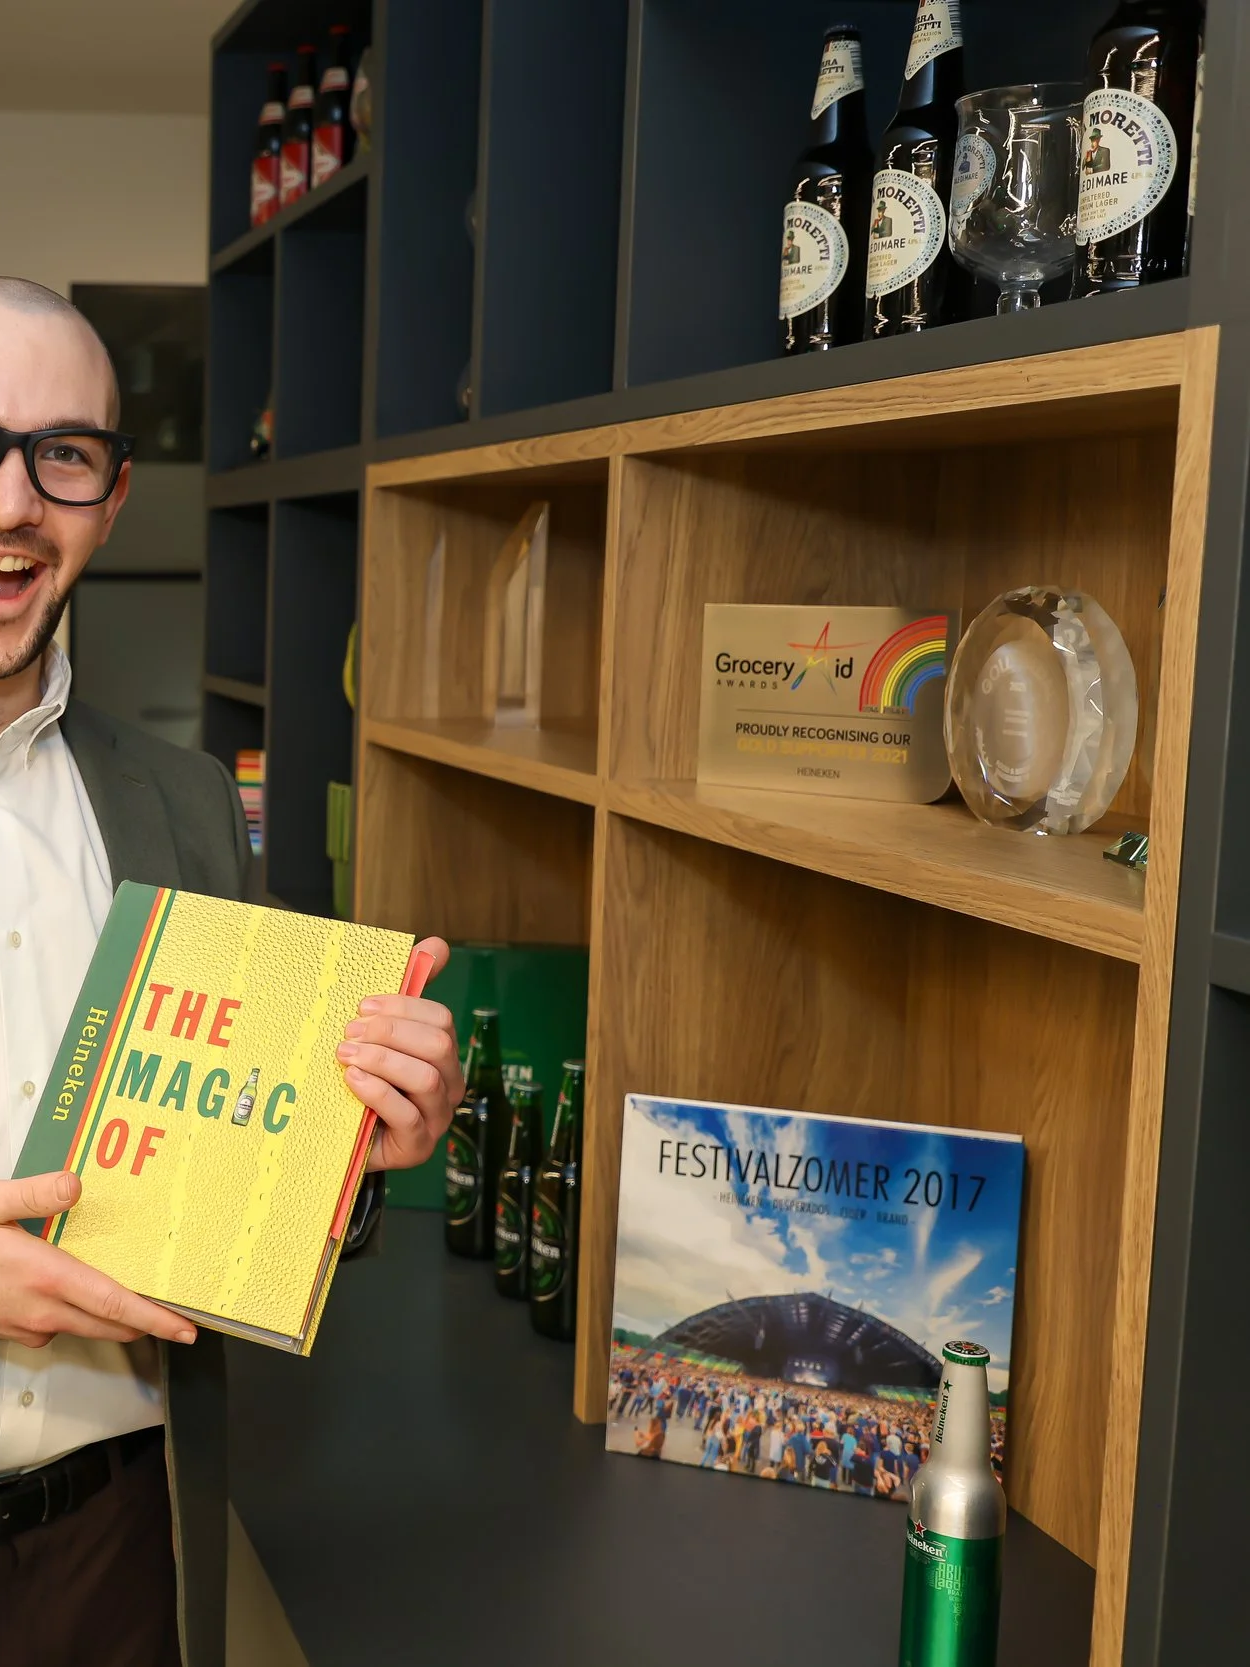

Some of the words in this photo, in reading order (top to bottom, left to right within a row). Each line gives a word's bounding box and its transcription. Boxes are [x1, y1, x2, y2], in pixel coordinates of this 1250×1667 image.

[1089, 110, 1153, 167] MORETTI
[876, 186, 926, 235] MORETTI
[1095, 197, 1119, 208] LAGER
[786, 217, 830, 261] MORETTI
[715, 652, 795, 681] Grocery
[716, 680, 778, 690] AWARDS
[735, 722, 789, 737] PROUDLY
[792, 727, 879, 744] RECOGNISING
[882, 732, 911, 746] OUR
[869, 747, 909, 764] 2021
[797, 767, 841, 779] HEINEKEN
[143, 983, 243, 1048] THE
[52, 1006, 109, 1121] Heineken
[96, 1118, 166, 1176] OF
[658, 1139, 890, 1202] FESTIVALZOMER
[903, 1168, 987, 1212] 2017
[935, 1393, 949, 1444] Heineken
